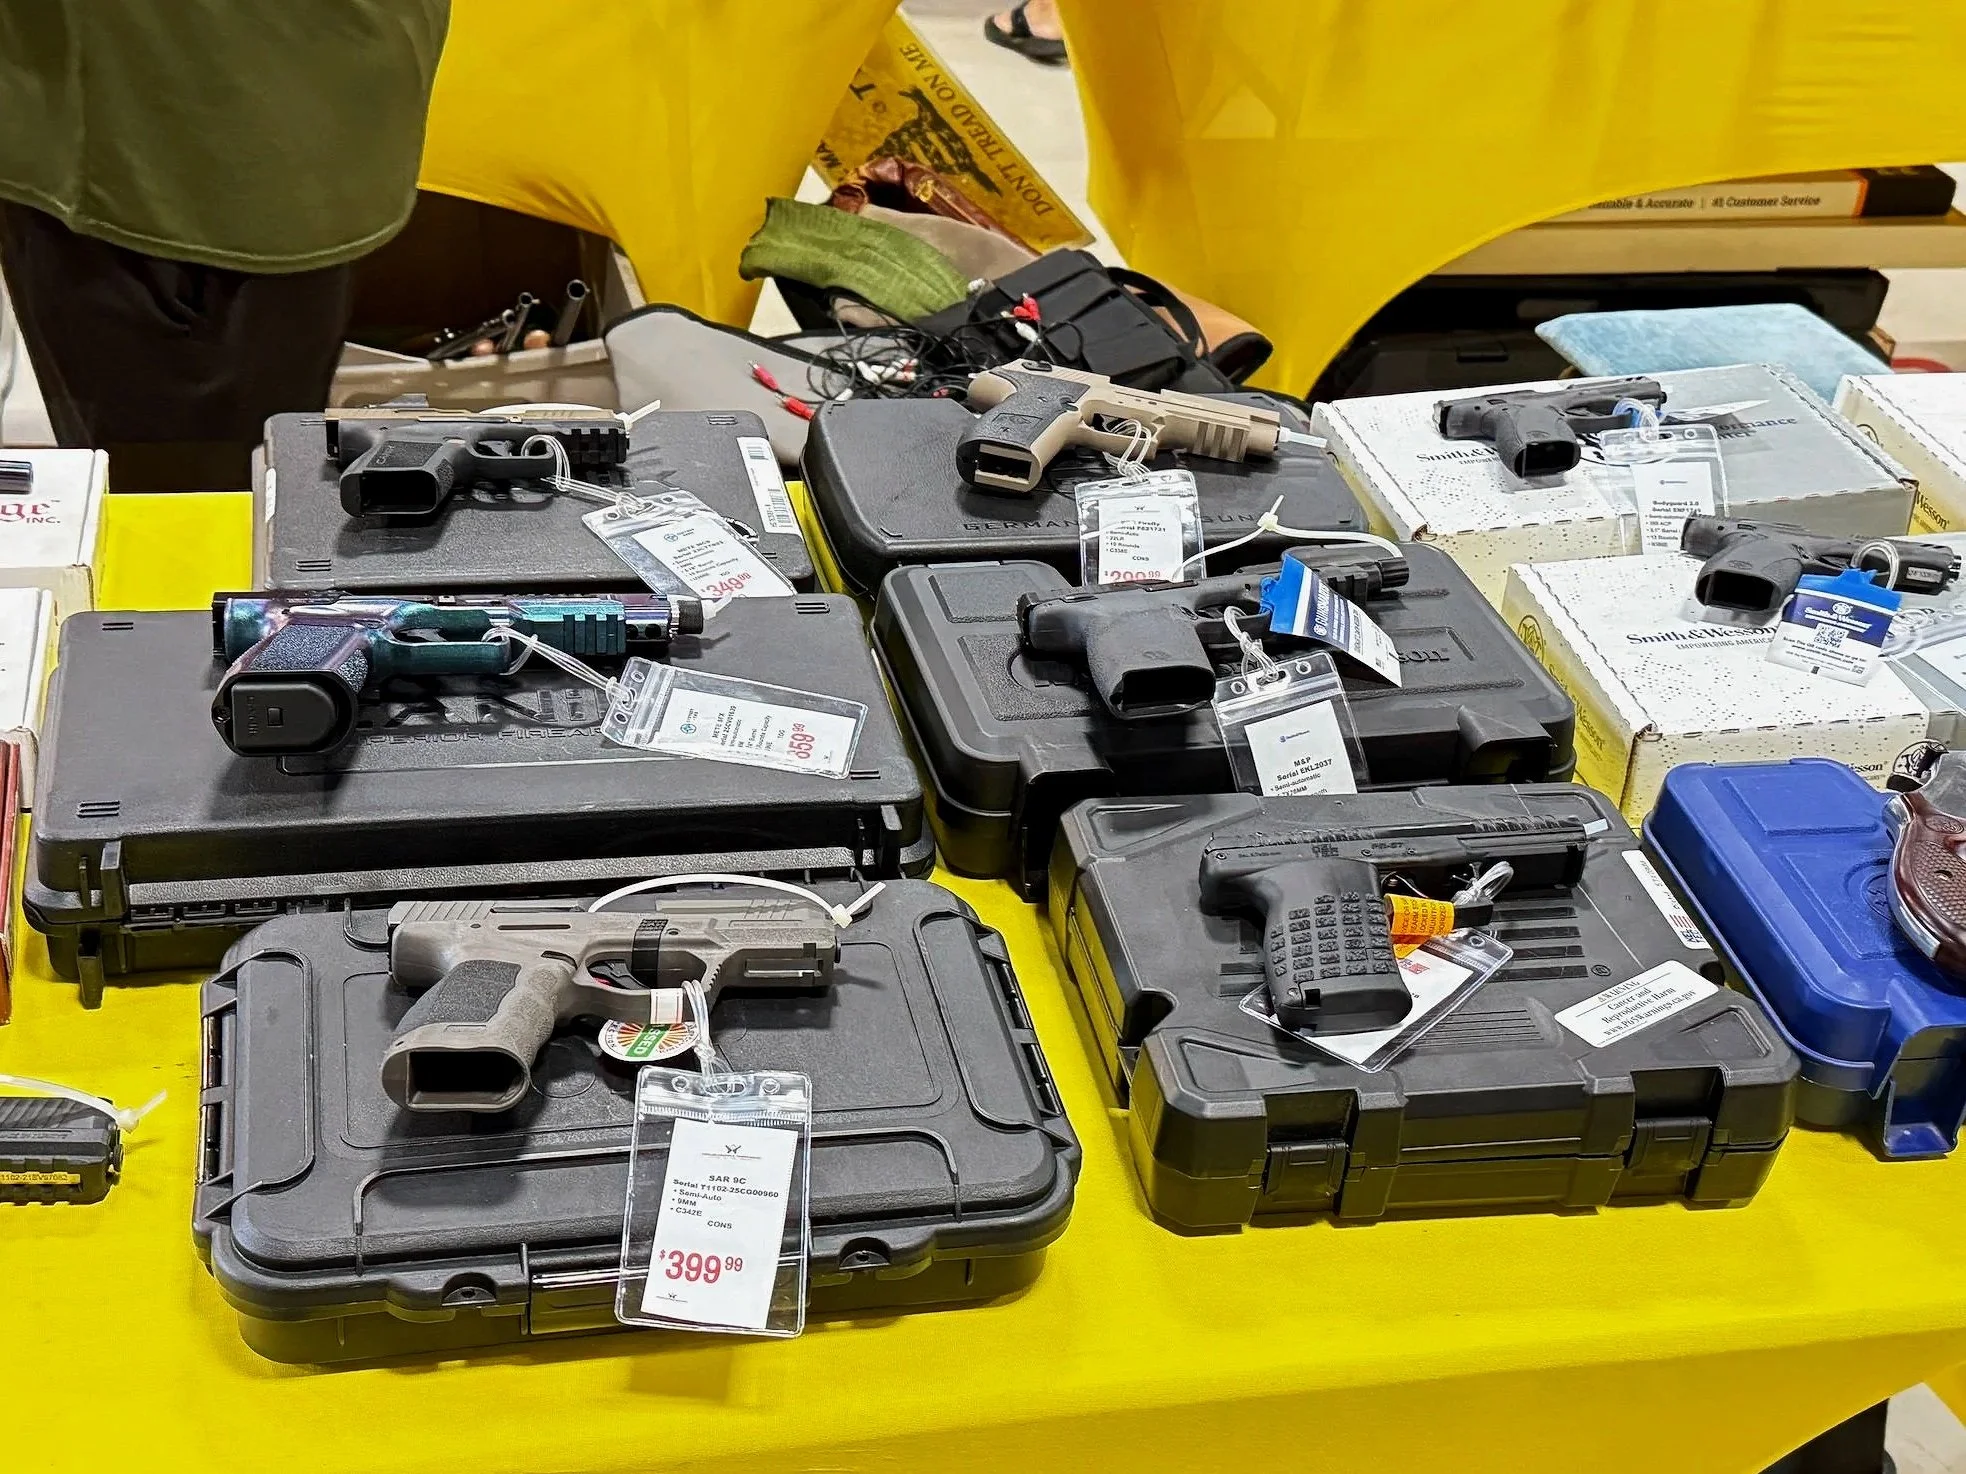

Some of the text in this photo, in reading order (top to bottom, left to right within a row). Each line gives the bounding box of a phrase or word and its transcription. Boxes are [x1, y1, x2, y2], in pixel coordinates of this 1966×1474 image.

[899, 41, 1054, 217] DON'T TREAD ON ME
[1645, 197, 1694, 209] Accurate
[1726, 196, 1778, 208] Customer
[1780, 195, 1821, 206] Service
[1676, 639, 1734, 650] EMPOWERING
[1293, 756, 1312, 768] M&P
[1276, 769, 1300, 782] Serial
[1603, 980, 1641, 1000] WARNING
[1601, 986, 1677, 1025] Reproductive Harm
[1607, 987, 1652, 1011] Cancer and
[672, 1178, 699, 1190] Serial
[708, 1174, 748, 1185] SAR 9C
[677, 1197, 697, 1207] 9MM
[679, 1189, 722, 1202] Semi-Auto
[706, 1220, 733, 1230] CONS
[659, 1249, 744, 1284] $399 99
